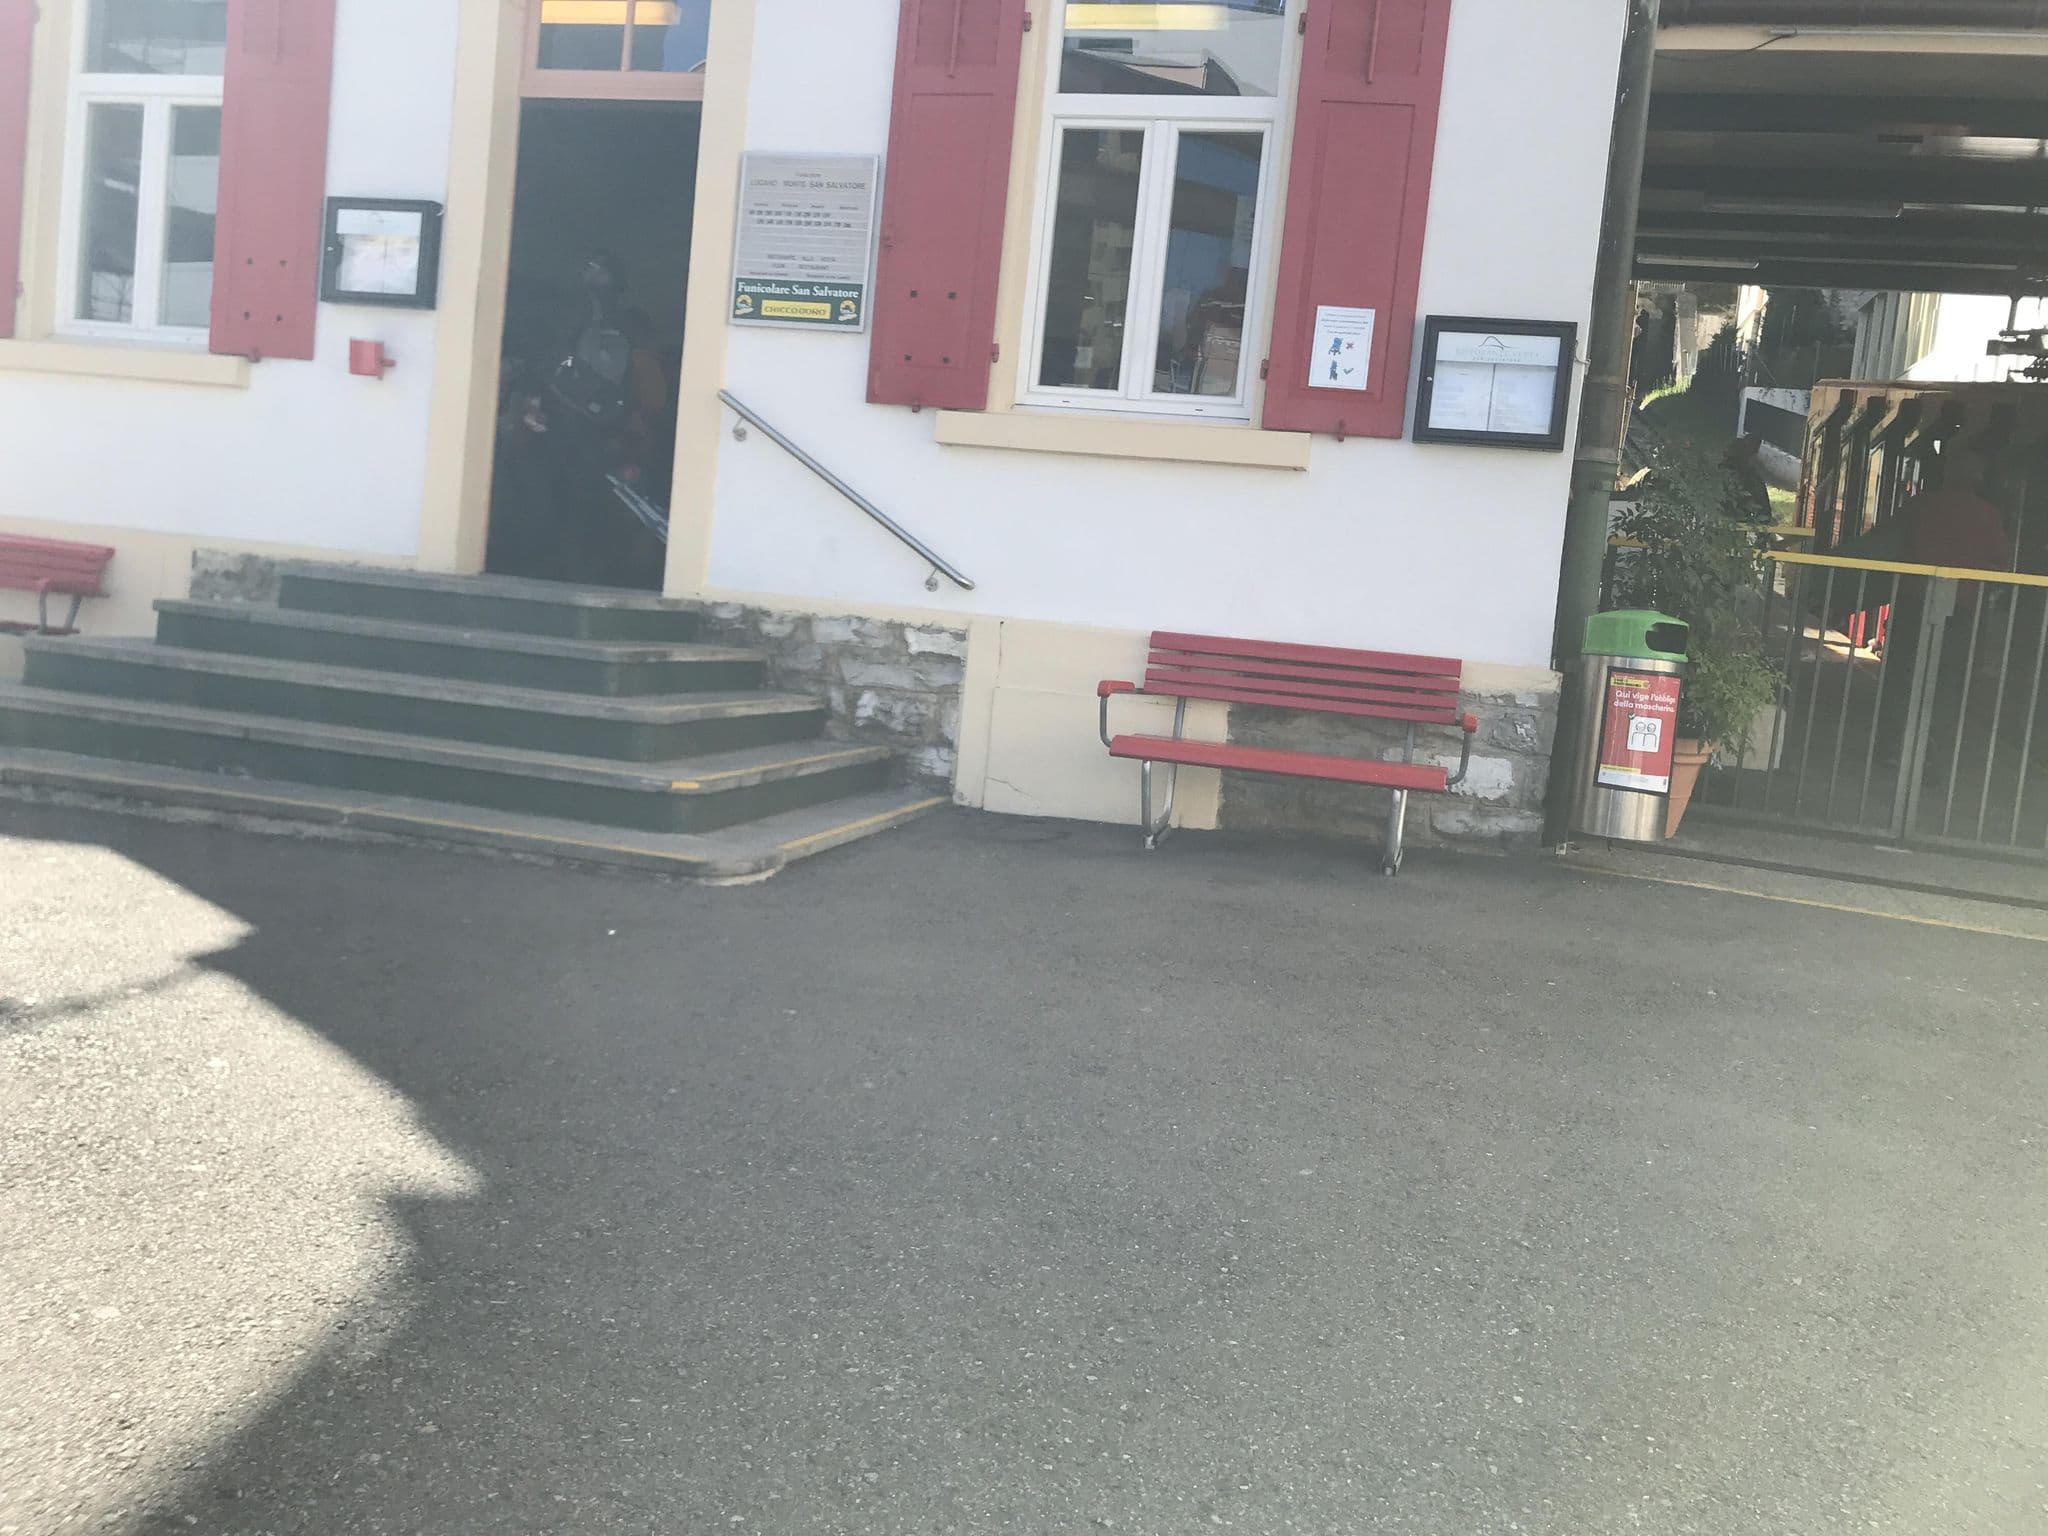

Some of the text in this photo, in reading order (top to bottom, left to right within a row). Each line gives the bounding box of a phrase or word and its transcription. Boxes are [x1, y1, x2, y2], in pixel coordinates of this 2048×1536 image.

[826, 182, 865, 190] SALVATORE
[737, 281, 860, 299] Funicolare San Salvatore
[1616, 690, 1631, 698] Qui
[1632, 693, 1649, 702] vige
[1613, 699, 1633, 708] della
